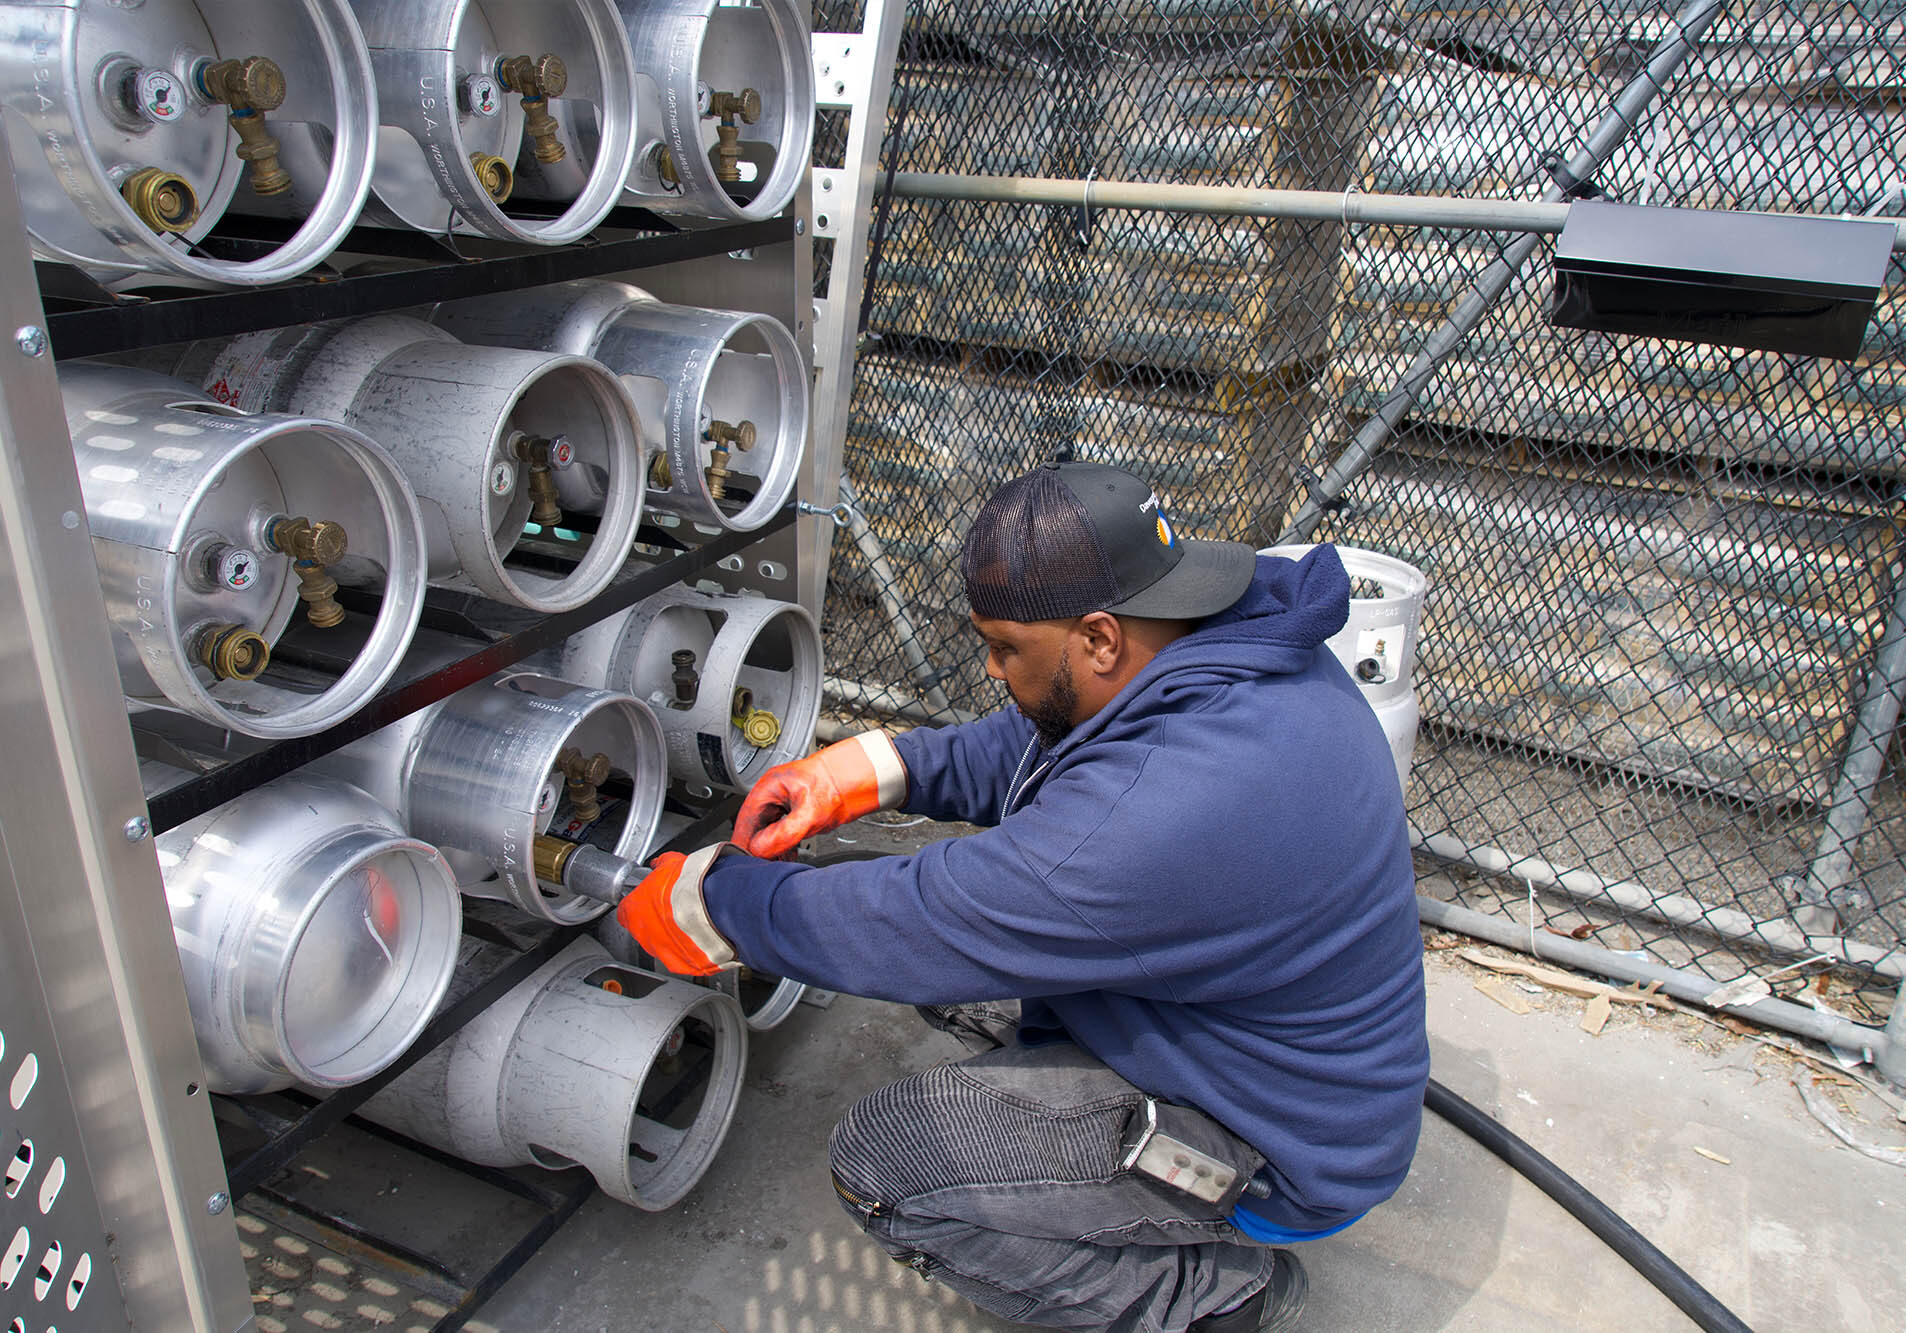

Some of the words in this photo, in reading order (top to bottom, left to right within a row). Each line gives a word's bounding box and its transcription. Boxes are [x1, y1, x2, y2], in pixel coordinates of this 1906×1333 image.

[419, 76, 439, 136] U.S.A.
[136, 574, 154, 638] U.S.A.
[503, 827, 516, 869] U.S.A.
